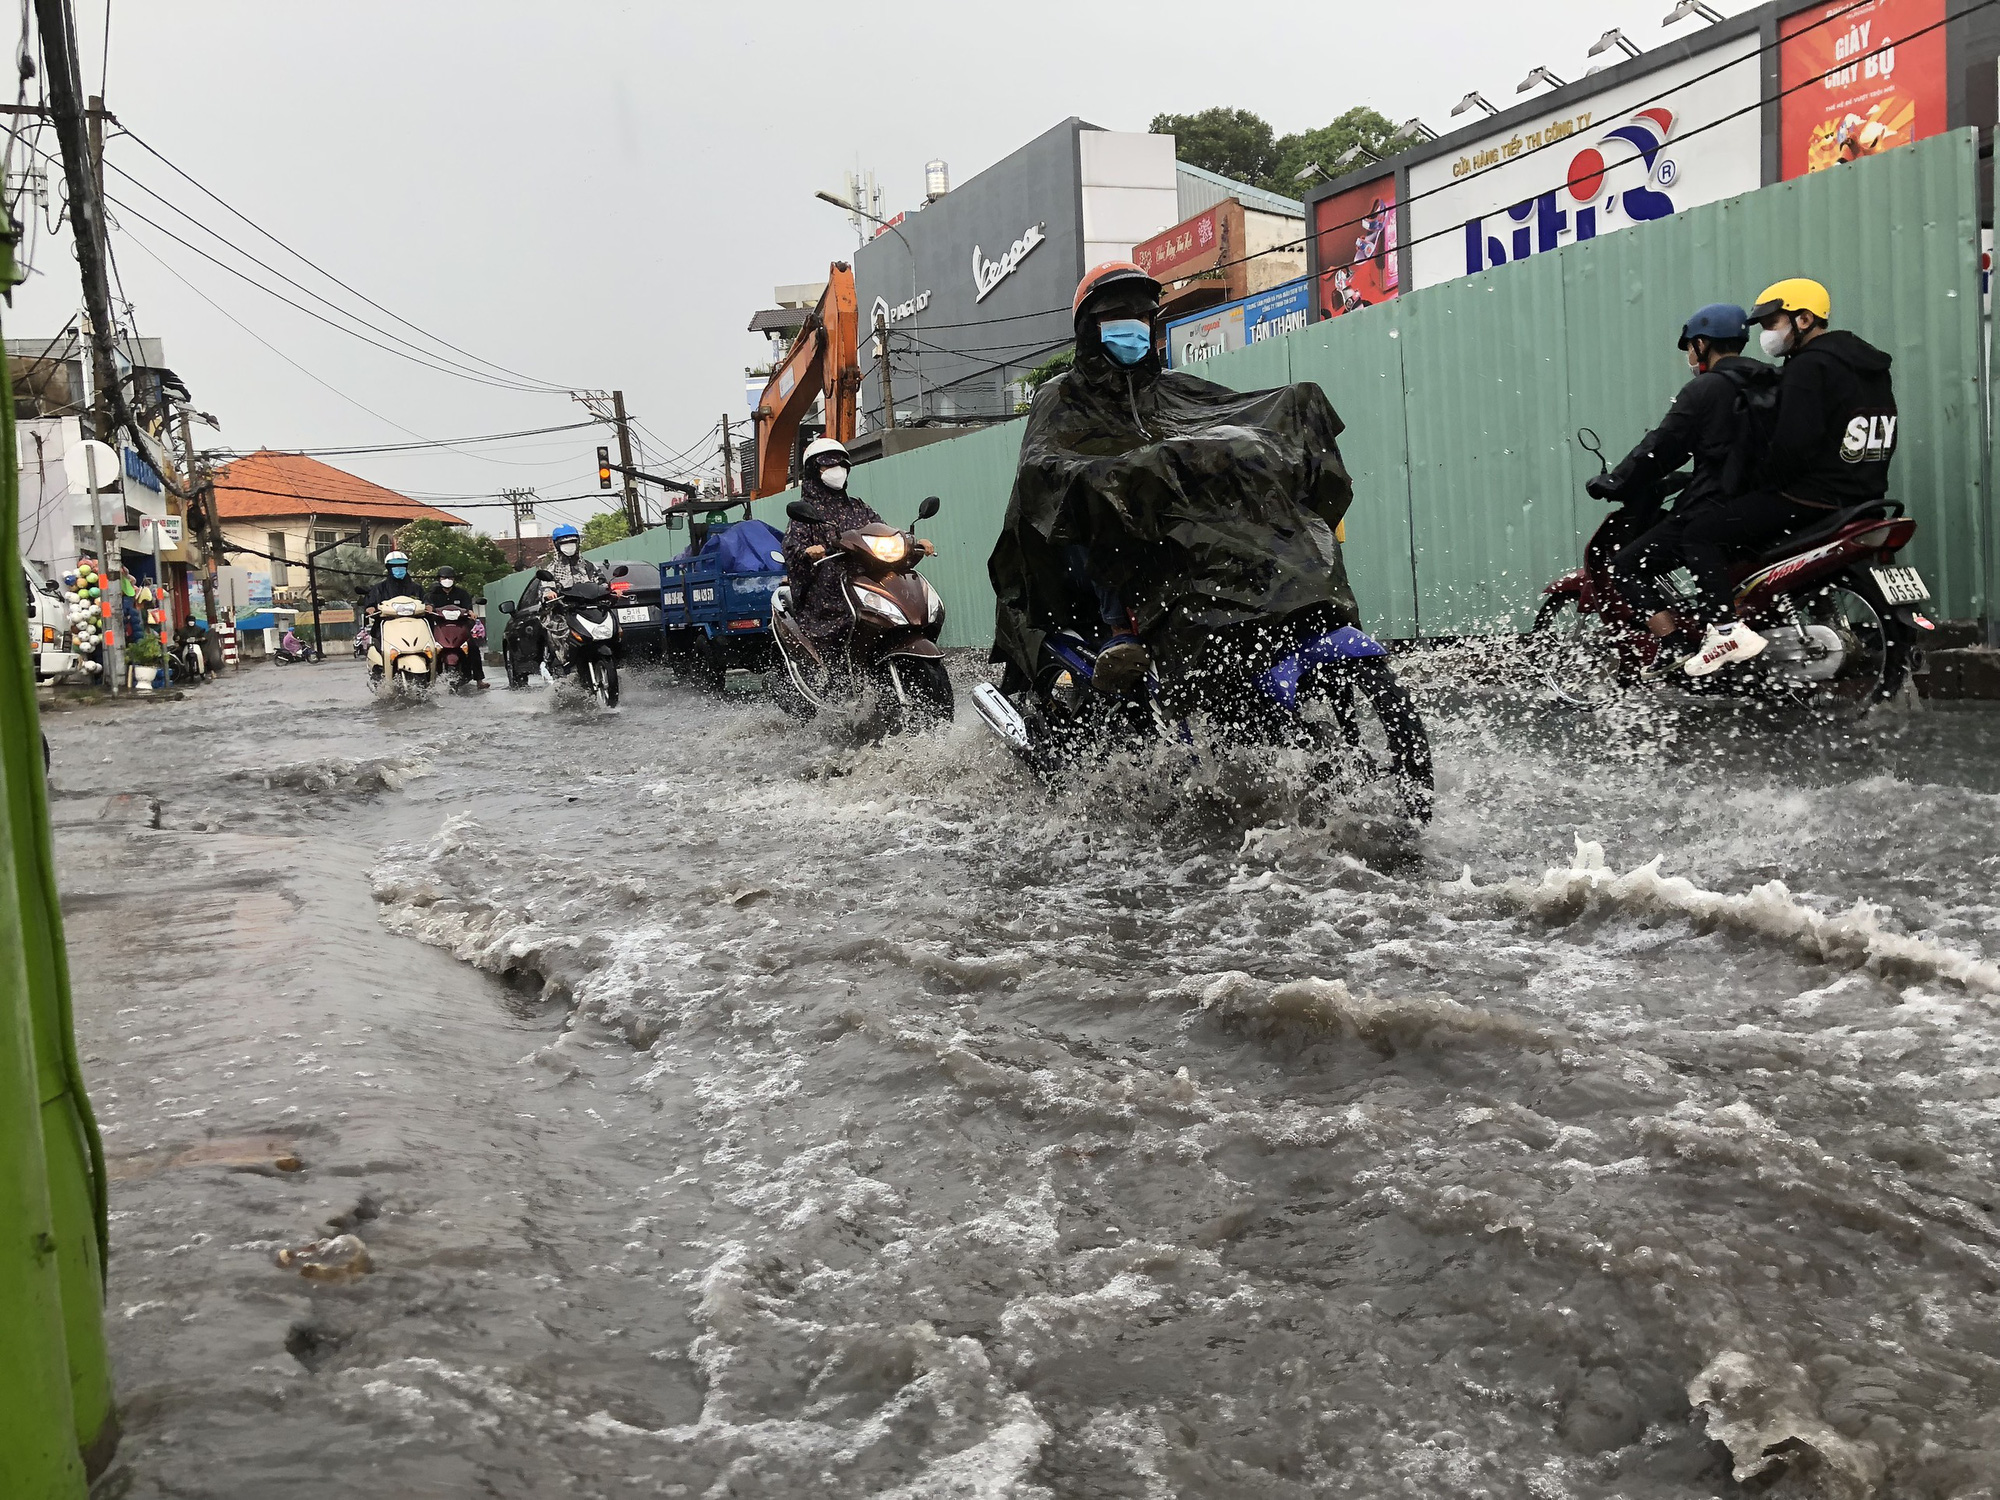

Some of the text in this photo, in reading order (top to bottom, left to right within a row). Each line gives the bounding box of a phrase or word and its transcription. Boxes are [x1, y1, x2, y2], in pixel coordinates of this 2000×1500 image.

[1835, 20, 1871, 61] GIÀY
[1824, 36, 1894, 89] CHẠY BỘ
[1453, 112, 1592, 177] CỬA HÀNG TIẾP THỊ CÔNG TY
[972, 225, 1046, 304] Vespa
[1249, 315, 1269, 343] TẤN
[1271, 309, 1306, 337] THÀNH
[1842, 415, 1897, 456] SLY
[1889, 584, 1923, 600] 0555
